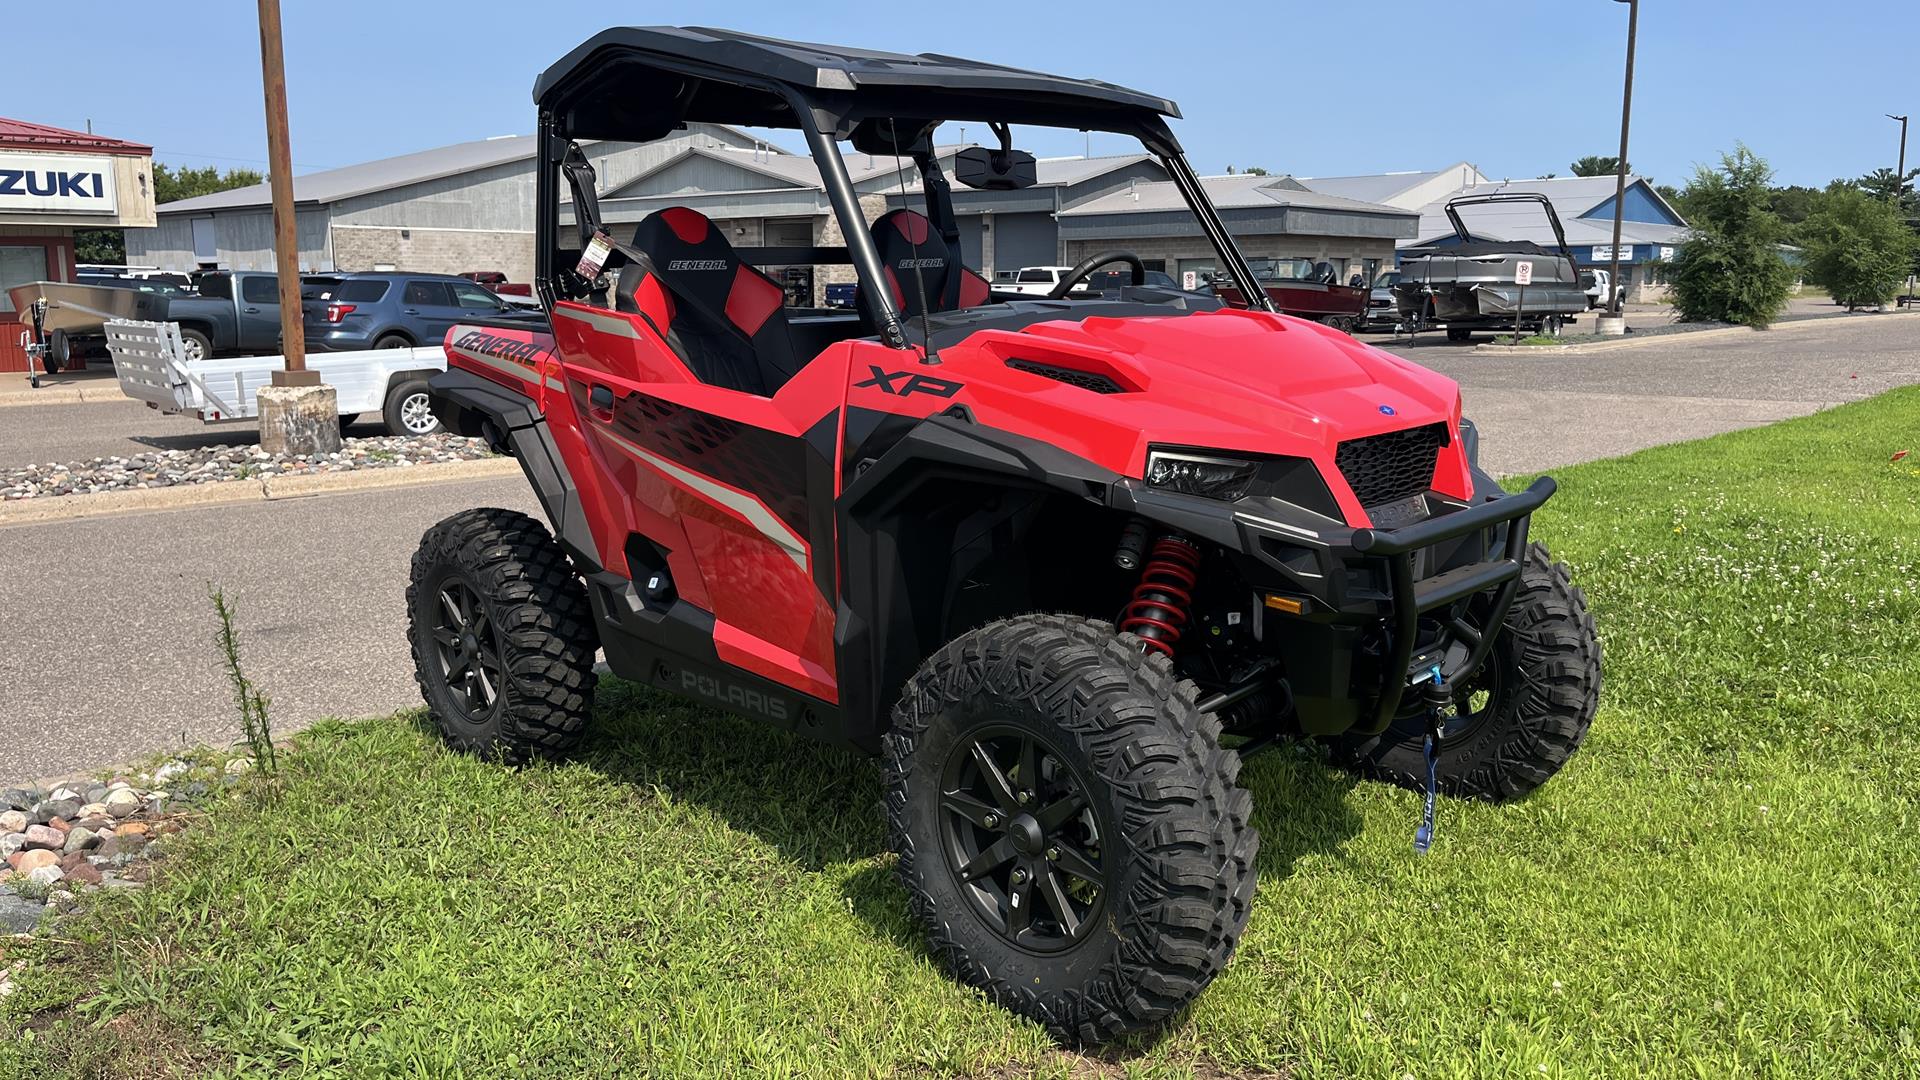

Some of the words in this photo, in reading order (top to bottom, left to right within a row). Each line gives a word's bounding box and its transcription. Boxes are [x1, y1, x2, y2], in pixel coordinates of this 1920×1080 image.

[0, 169, 104, 198] ZUKI
[668, 260, 728, 271] GENERAL
[453, 331, 544, 367] GENERAL
[852, 364, 965, 398] XP
[681, 670, 788, 720] POLARIS
